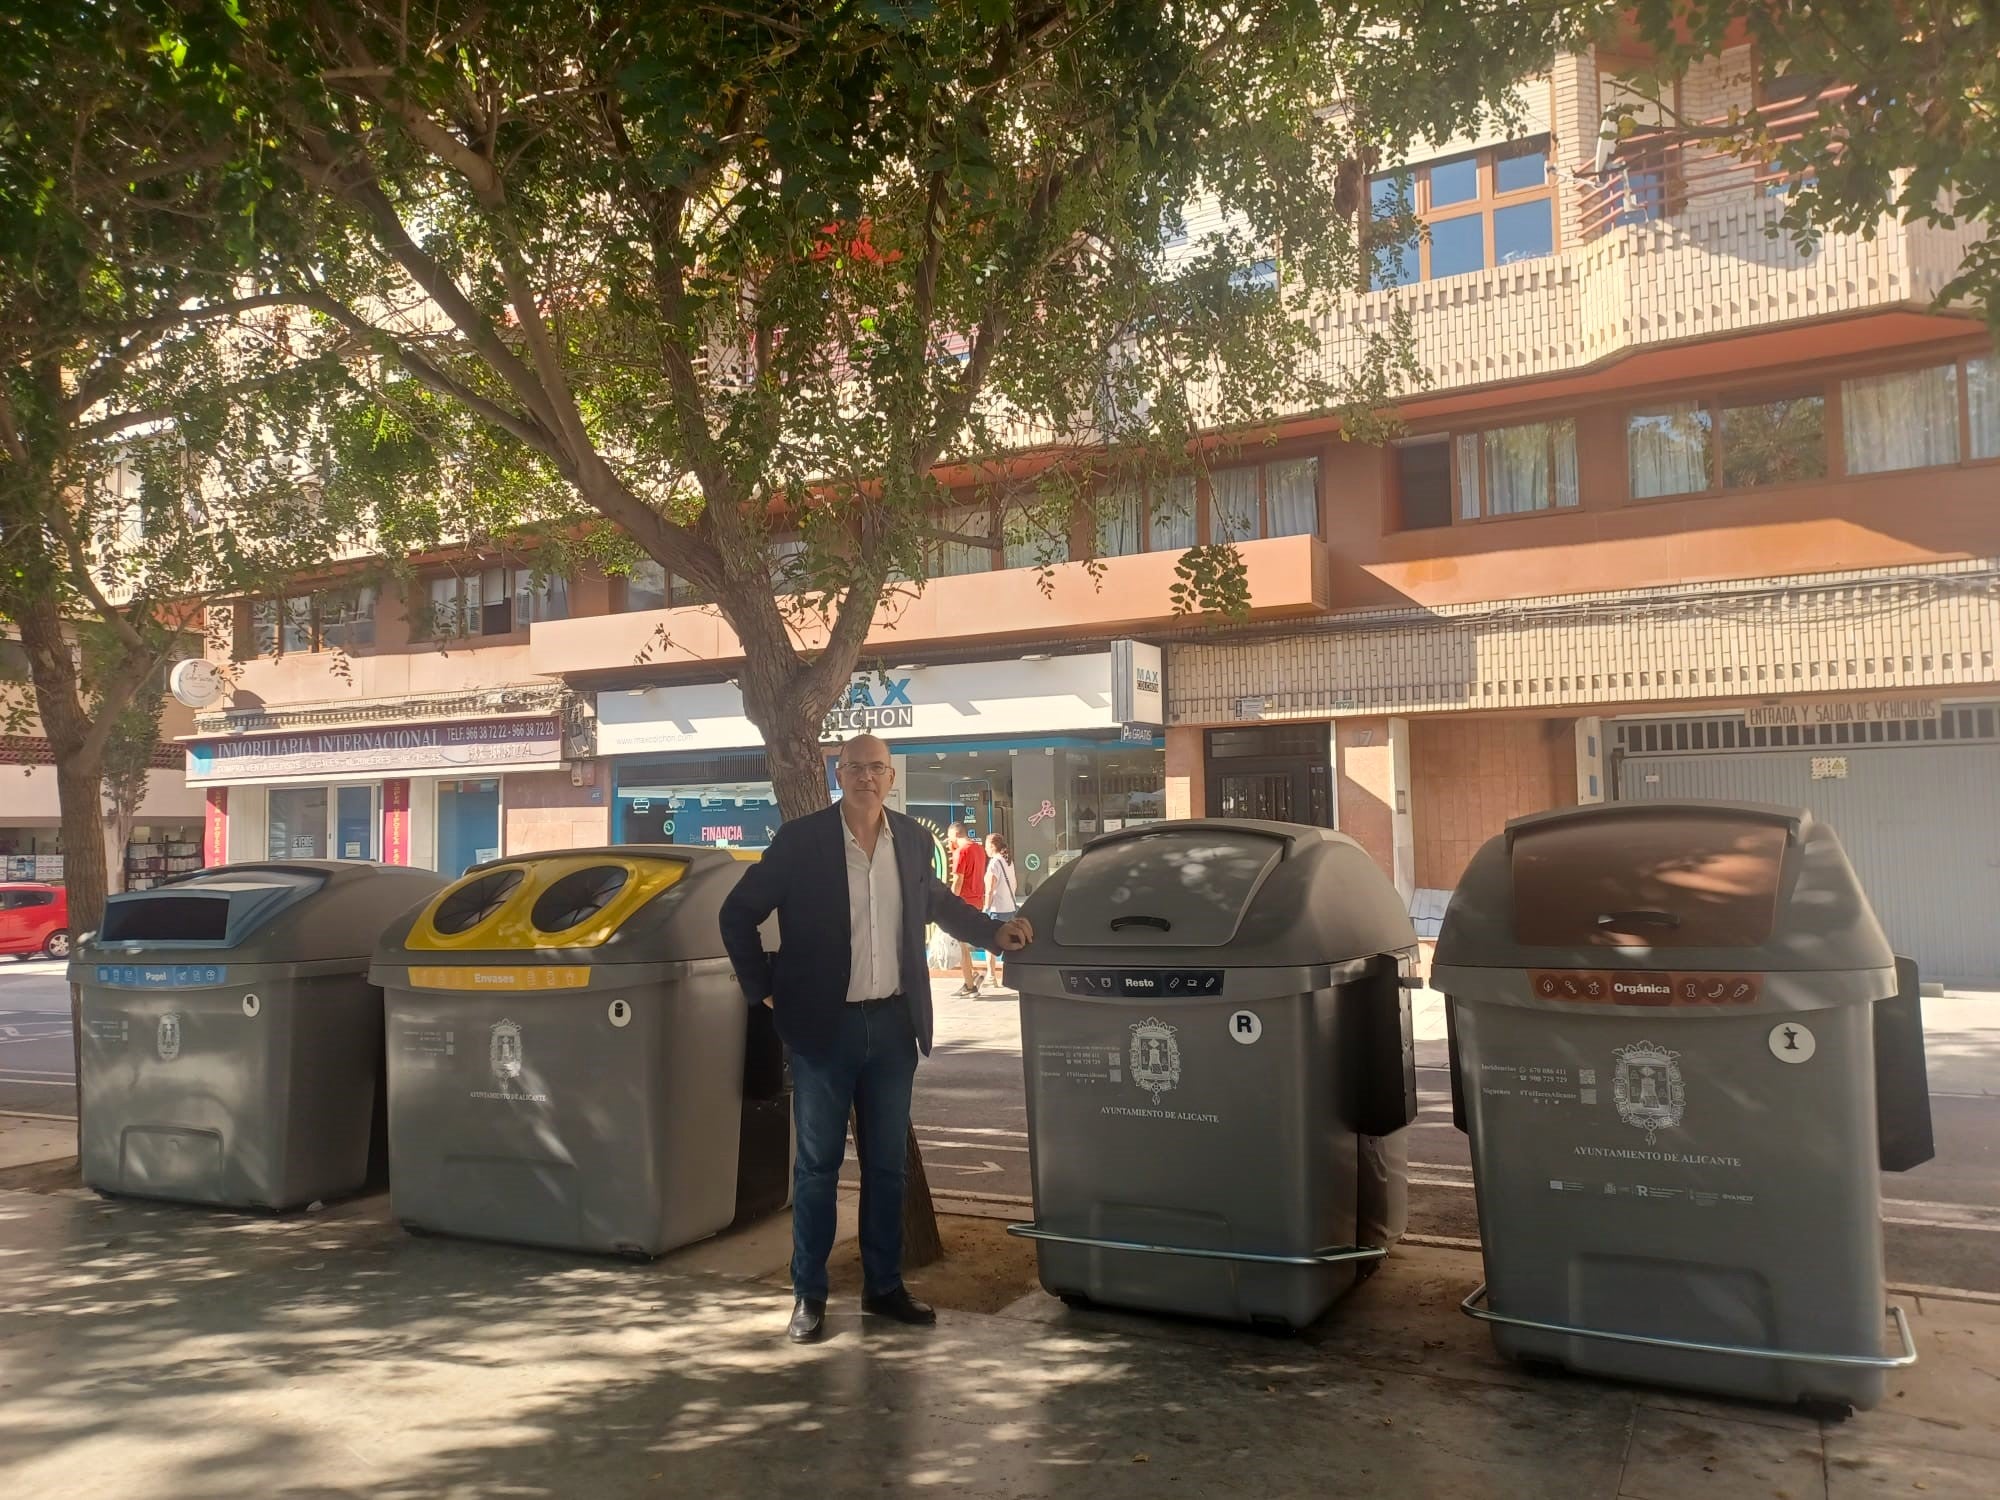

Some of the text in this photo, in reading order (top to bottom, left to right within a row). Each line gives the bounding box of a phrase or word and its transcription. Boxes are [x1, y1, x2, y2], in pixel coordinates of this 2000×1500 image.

[1137, 668, 1158, 682] MAX
[849, 678, 912, 706] AX
[1750, 706, 1797, 725] ENTRADA
[1802, 706, 1809, 723] Y
[1816, 704, 1854, 722] SALIDA
[1858, 703, 1870, 720] DE
[465, 726, 478, 740] 966
[478, 725, 487, 739] 38
[489, 725, 497, 739] 72
[498, 724, 507, 738] 22
[511, 723, 524, 737] 966
[525, 722, 534, 737] 38
[535, 722, 544, 736] 72
[545, 721, 554, 735] 23
[217, 729, 441, 760] INMOBILIARIA INTERNACIONAL
[701, 826, 743, 841] FINANCIA
[145, 972, 167, 982] Papel
[474, 974, 515, 983] Envases
[1125, 978, 1154, 987] Resto
[1614, 980, 1671, 995] Orgánica
[1236, 1015, 1252, 1033] R
[1100, 1107, 1219, 1123] AYUNTAMIENTO DE ALICANTE
[1574, 1146, 1741, 1167] AYUNTAMIENTO DE ALICANTE
